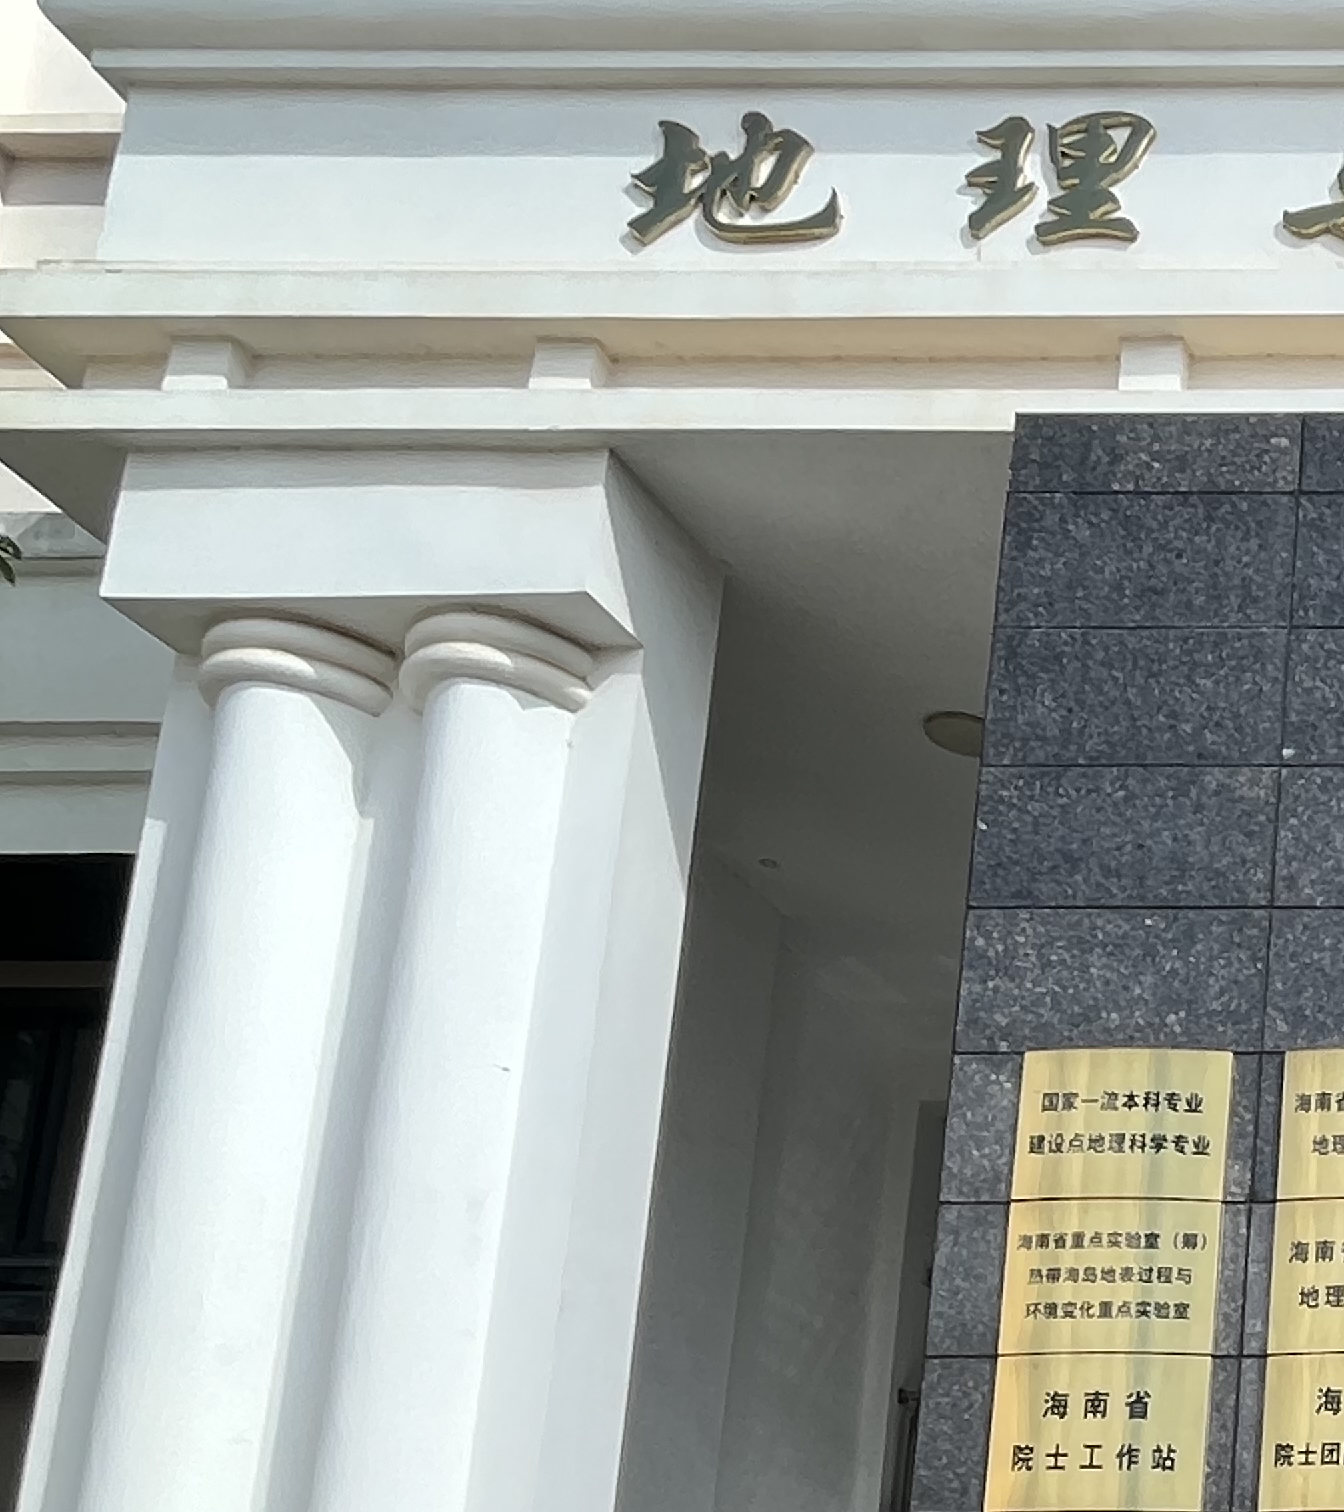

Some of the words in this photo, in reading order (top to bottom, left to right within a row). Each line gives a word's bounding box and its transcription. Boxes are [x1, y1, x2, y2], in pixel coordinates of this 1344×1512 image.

[1041, 1090, 1204, 1114] 国家一流本科专业
[1028, 1132, 1210, 1156] 建设点地理科学专业
[1025, 1300, 1190, 1320] 环境变化重点实验室
[1042, 1390, 1152, 1420] 海南省
[1011, 1442, 1178, 1472] 院士工作站
